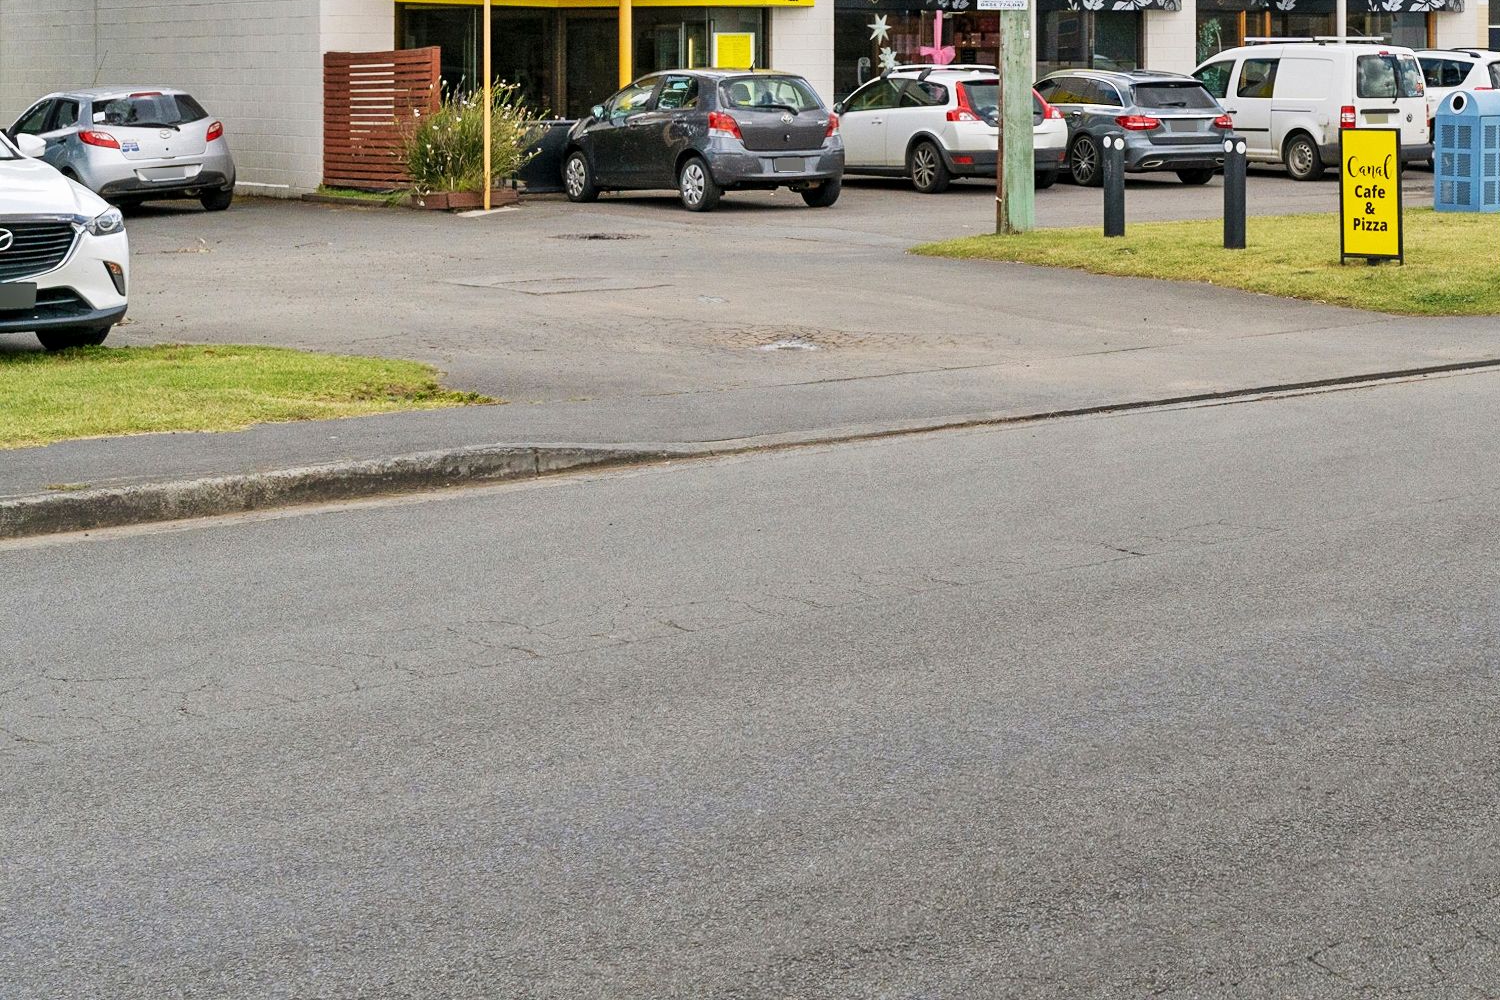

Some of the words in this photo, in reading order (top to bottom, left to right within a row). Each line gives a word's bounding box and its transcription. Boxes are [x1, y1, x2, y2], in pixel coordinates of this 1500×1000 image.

[1346, 153, 1392, 180] Canal
[1354, 185, 1386, 199] Cafe
[1364, 202, 1376, 215] &
[1353, 217, 1388, 232] Pizza
